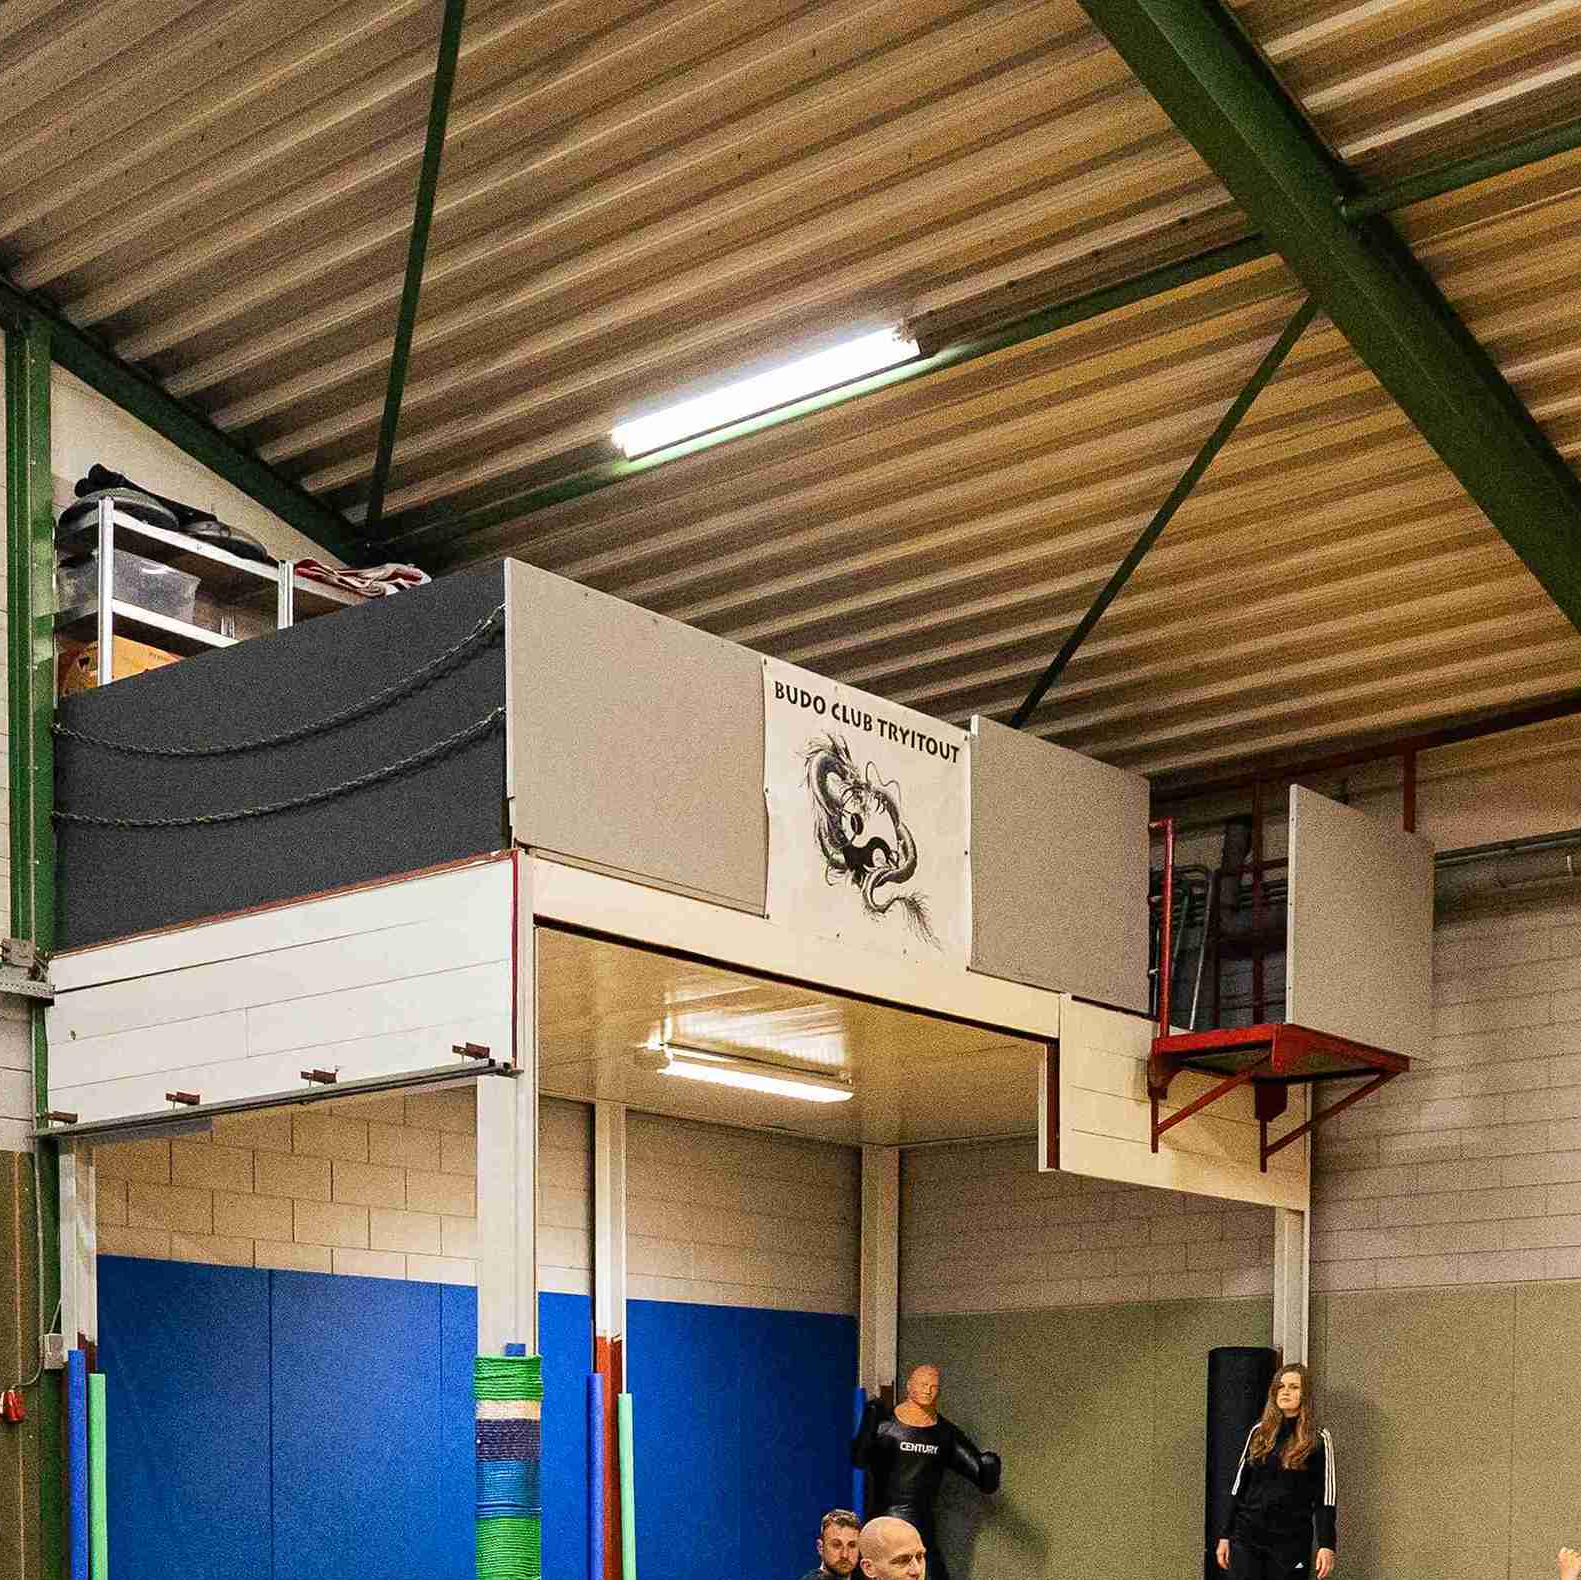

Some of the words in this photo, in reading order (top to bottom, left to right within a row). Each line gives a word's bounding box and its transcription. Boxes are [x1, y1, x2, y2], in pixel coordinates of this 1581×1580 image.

[774, 681, 826, 715] BUDO
[831, 703, 873, 732] CLUB
[877, 718, 960, 763] TRYITOUT
[900, 1441, 939, 1454] CENTURY
